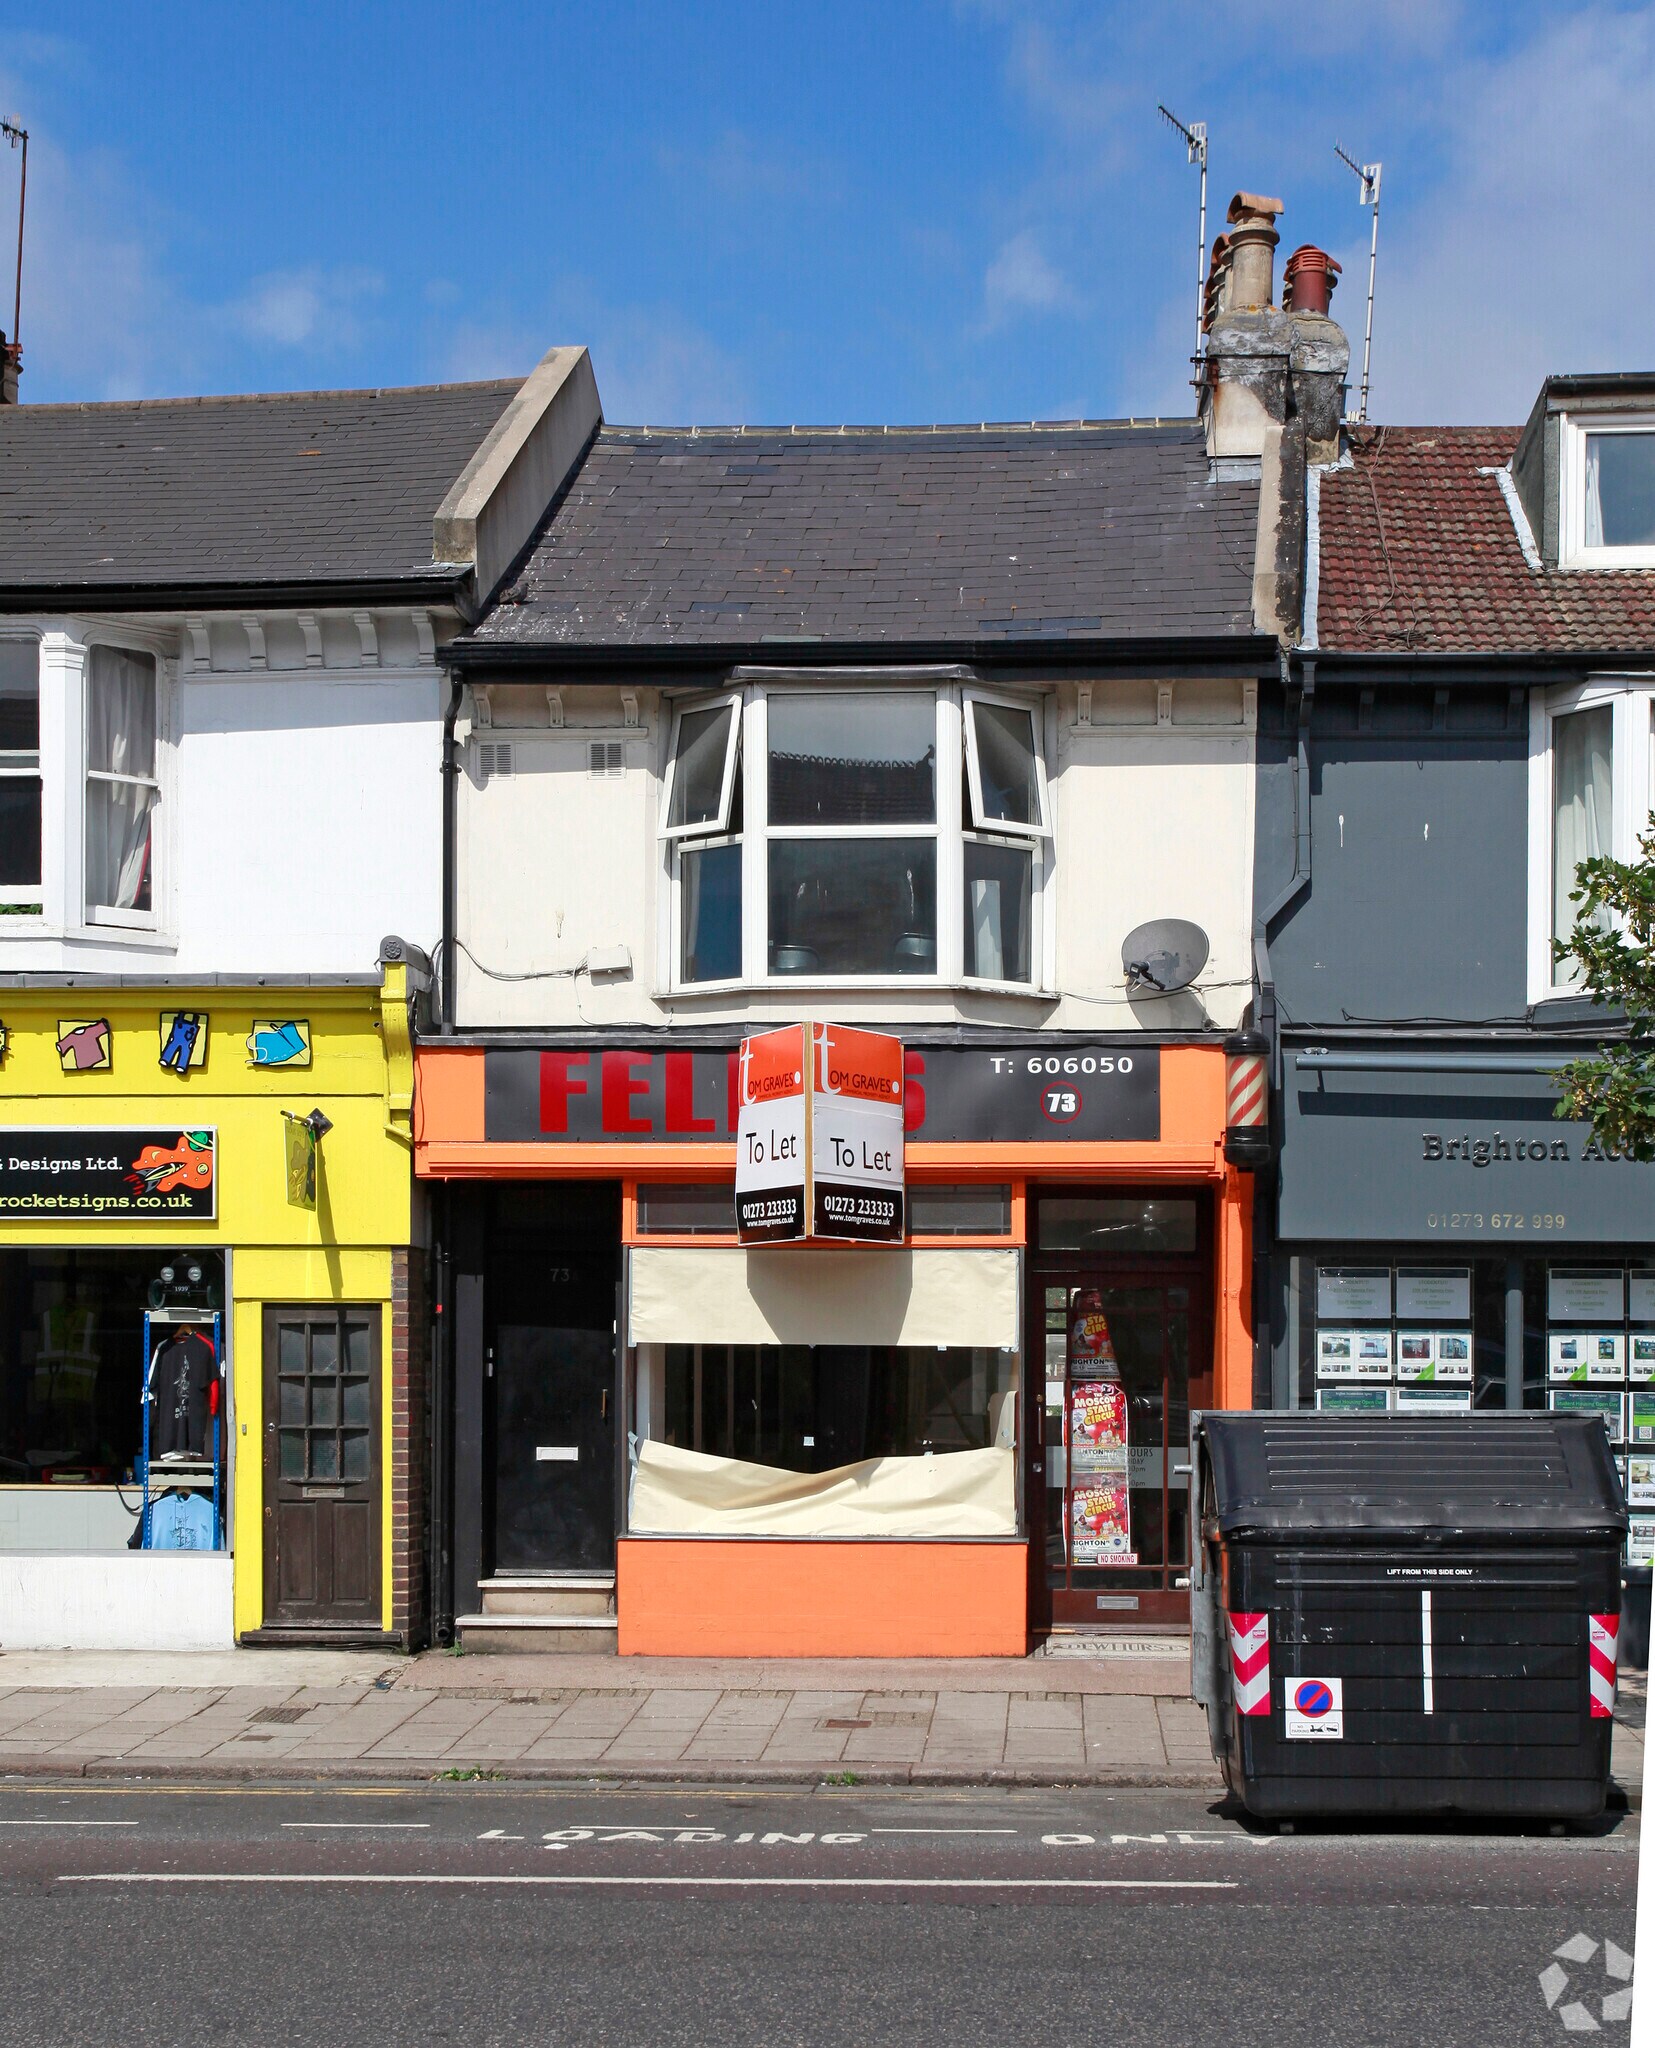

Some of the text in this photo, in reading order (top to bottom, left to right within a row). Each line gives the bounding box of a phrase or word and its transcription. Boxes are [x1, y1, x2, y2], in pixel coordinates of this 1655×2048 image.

[990, 1057, 1134, 1074] T: 606050
[764, 1072, 794, 1092] GRAVES
[852, 1074, 891, 1094] GRAVES
[1047, 1093, 1076, 1113] 73
[746, 1129, 797, 1164] To Let
[830, 1137, 892, 1171] To Let
[1422, 1131, 1570, 1167] Brighton
[8, 1157, 81, 1174] Designs
[86, 1157, 123, 1171] Ltd.
[0, 1194, 192, 1211] rocketsigns.co.uk
[742, 1199, 797, 1219] 01273 233333
[824, 1195, 895, 1217] 01273 233333
[747, 1216, 794, 1228] www.tomgraves.co.uk
[829, 1213, 891, 1226] www.tomgraves.co.uk
[1427, 1214, 1565, 1229] 01273 672 999
[1074, 1396, 1116, 1408] MOSCOW
[1087, 1403, 1112, 1416] STATE
[1084, 1410, 1115, 1426] CIRCUS
[1074, 1487, 1116, 1500] MOSCOW
[1087, 1495, 1112, 1508] STATE
[1085, 1501, 1116, 1517] CIRCUS
[1101, 1553, 1110, 1563] NO
[1110, 1553, 1135, 1563] SMOKING
[476, 1829, 1282, 1846] LOADING ONLY
